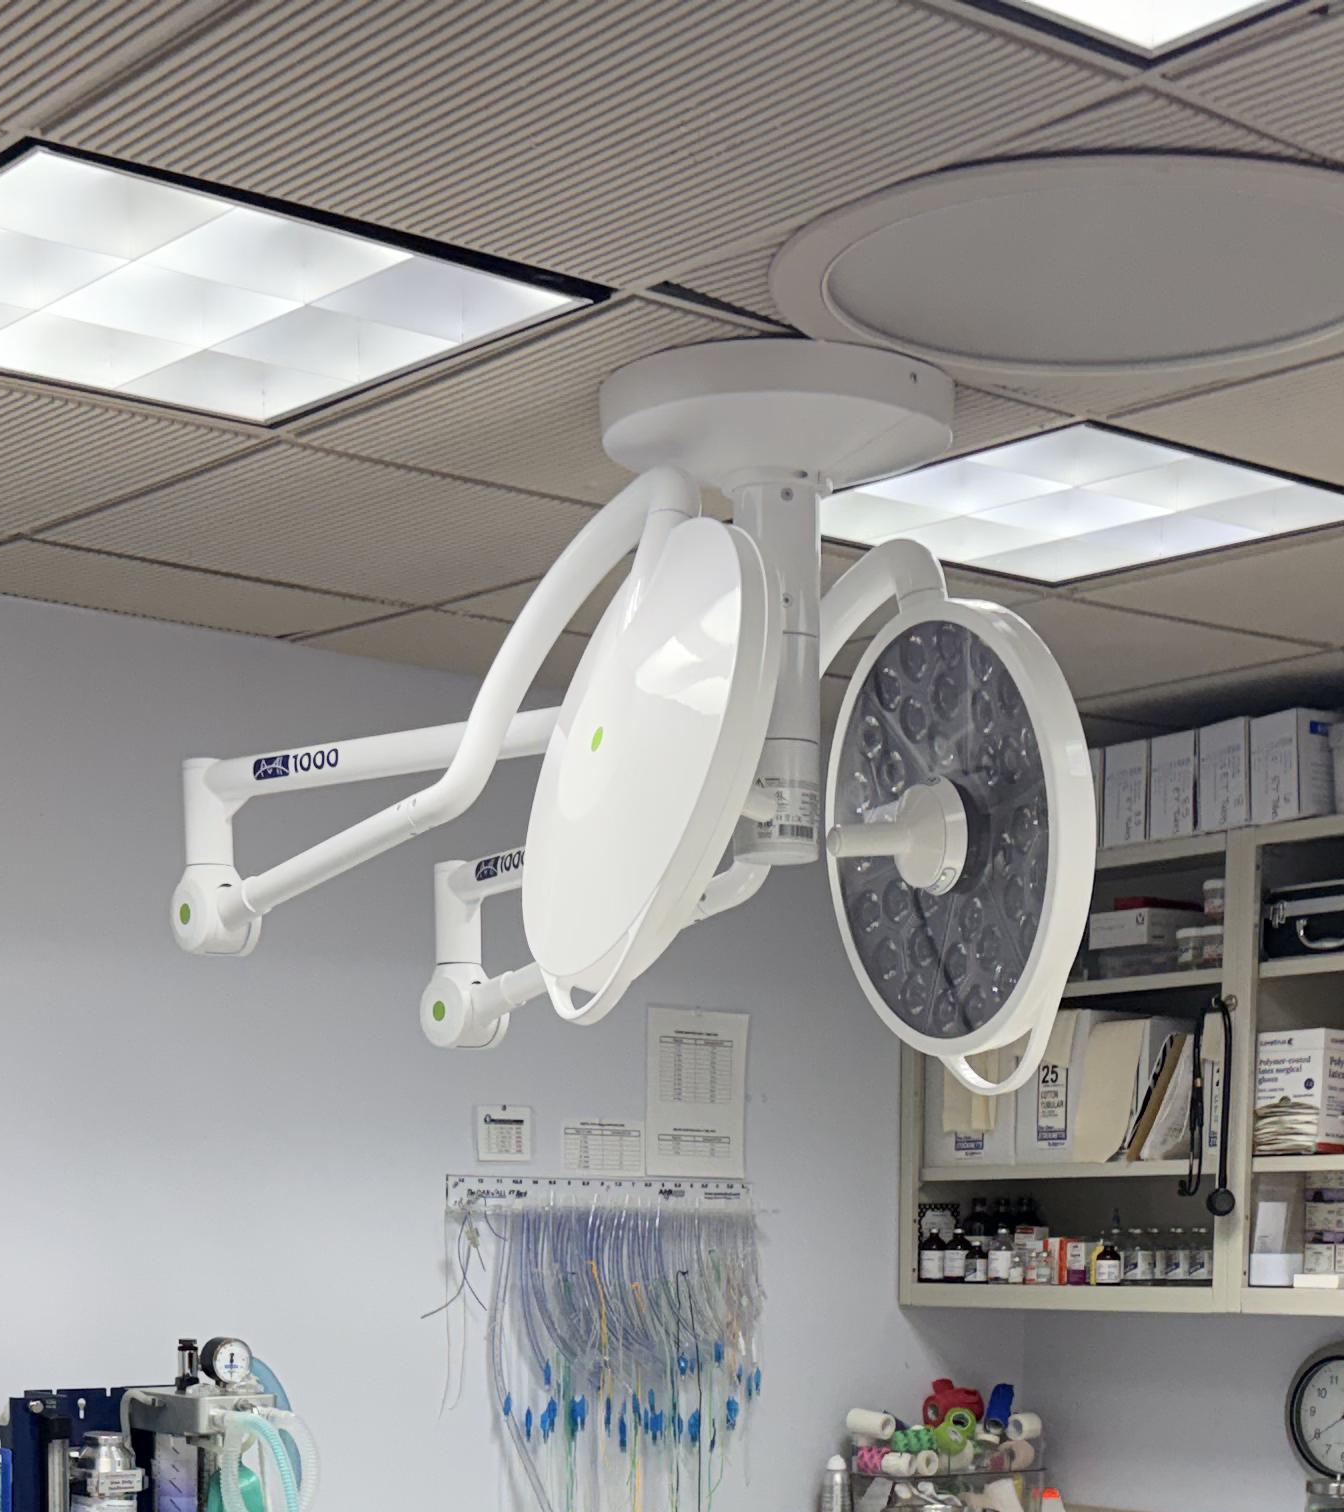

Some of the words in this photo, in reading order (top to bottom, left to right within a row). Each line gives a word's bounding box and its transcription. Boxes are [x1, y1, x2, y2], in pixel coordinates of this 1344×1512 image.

[292, 748, 339, 773] 1000
[1041, 1065, 1059, 1084] 25
[1317, 1387, 1328, 1400] 10
[1309, 1406, 1316, 1417] 9
